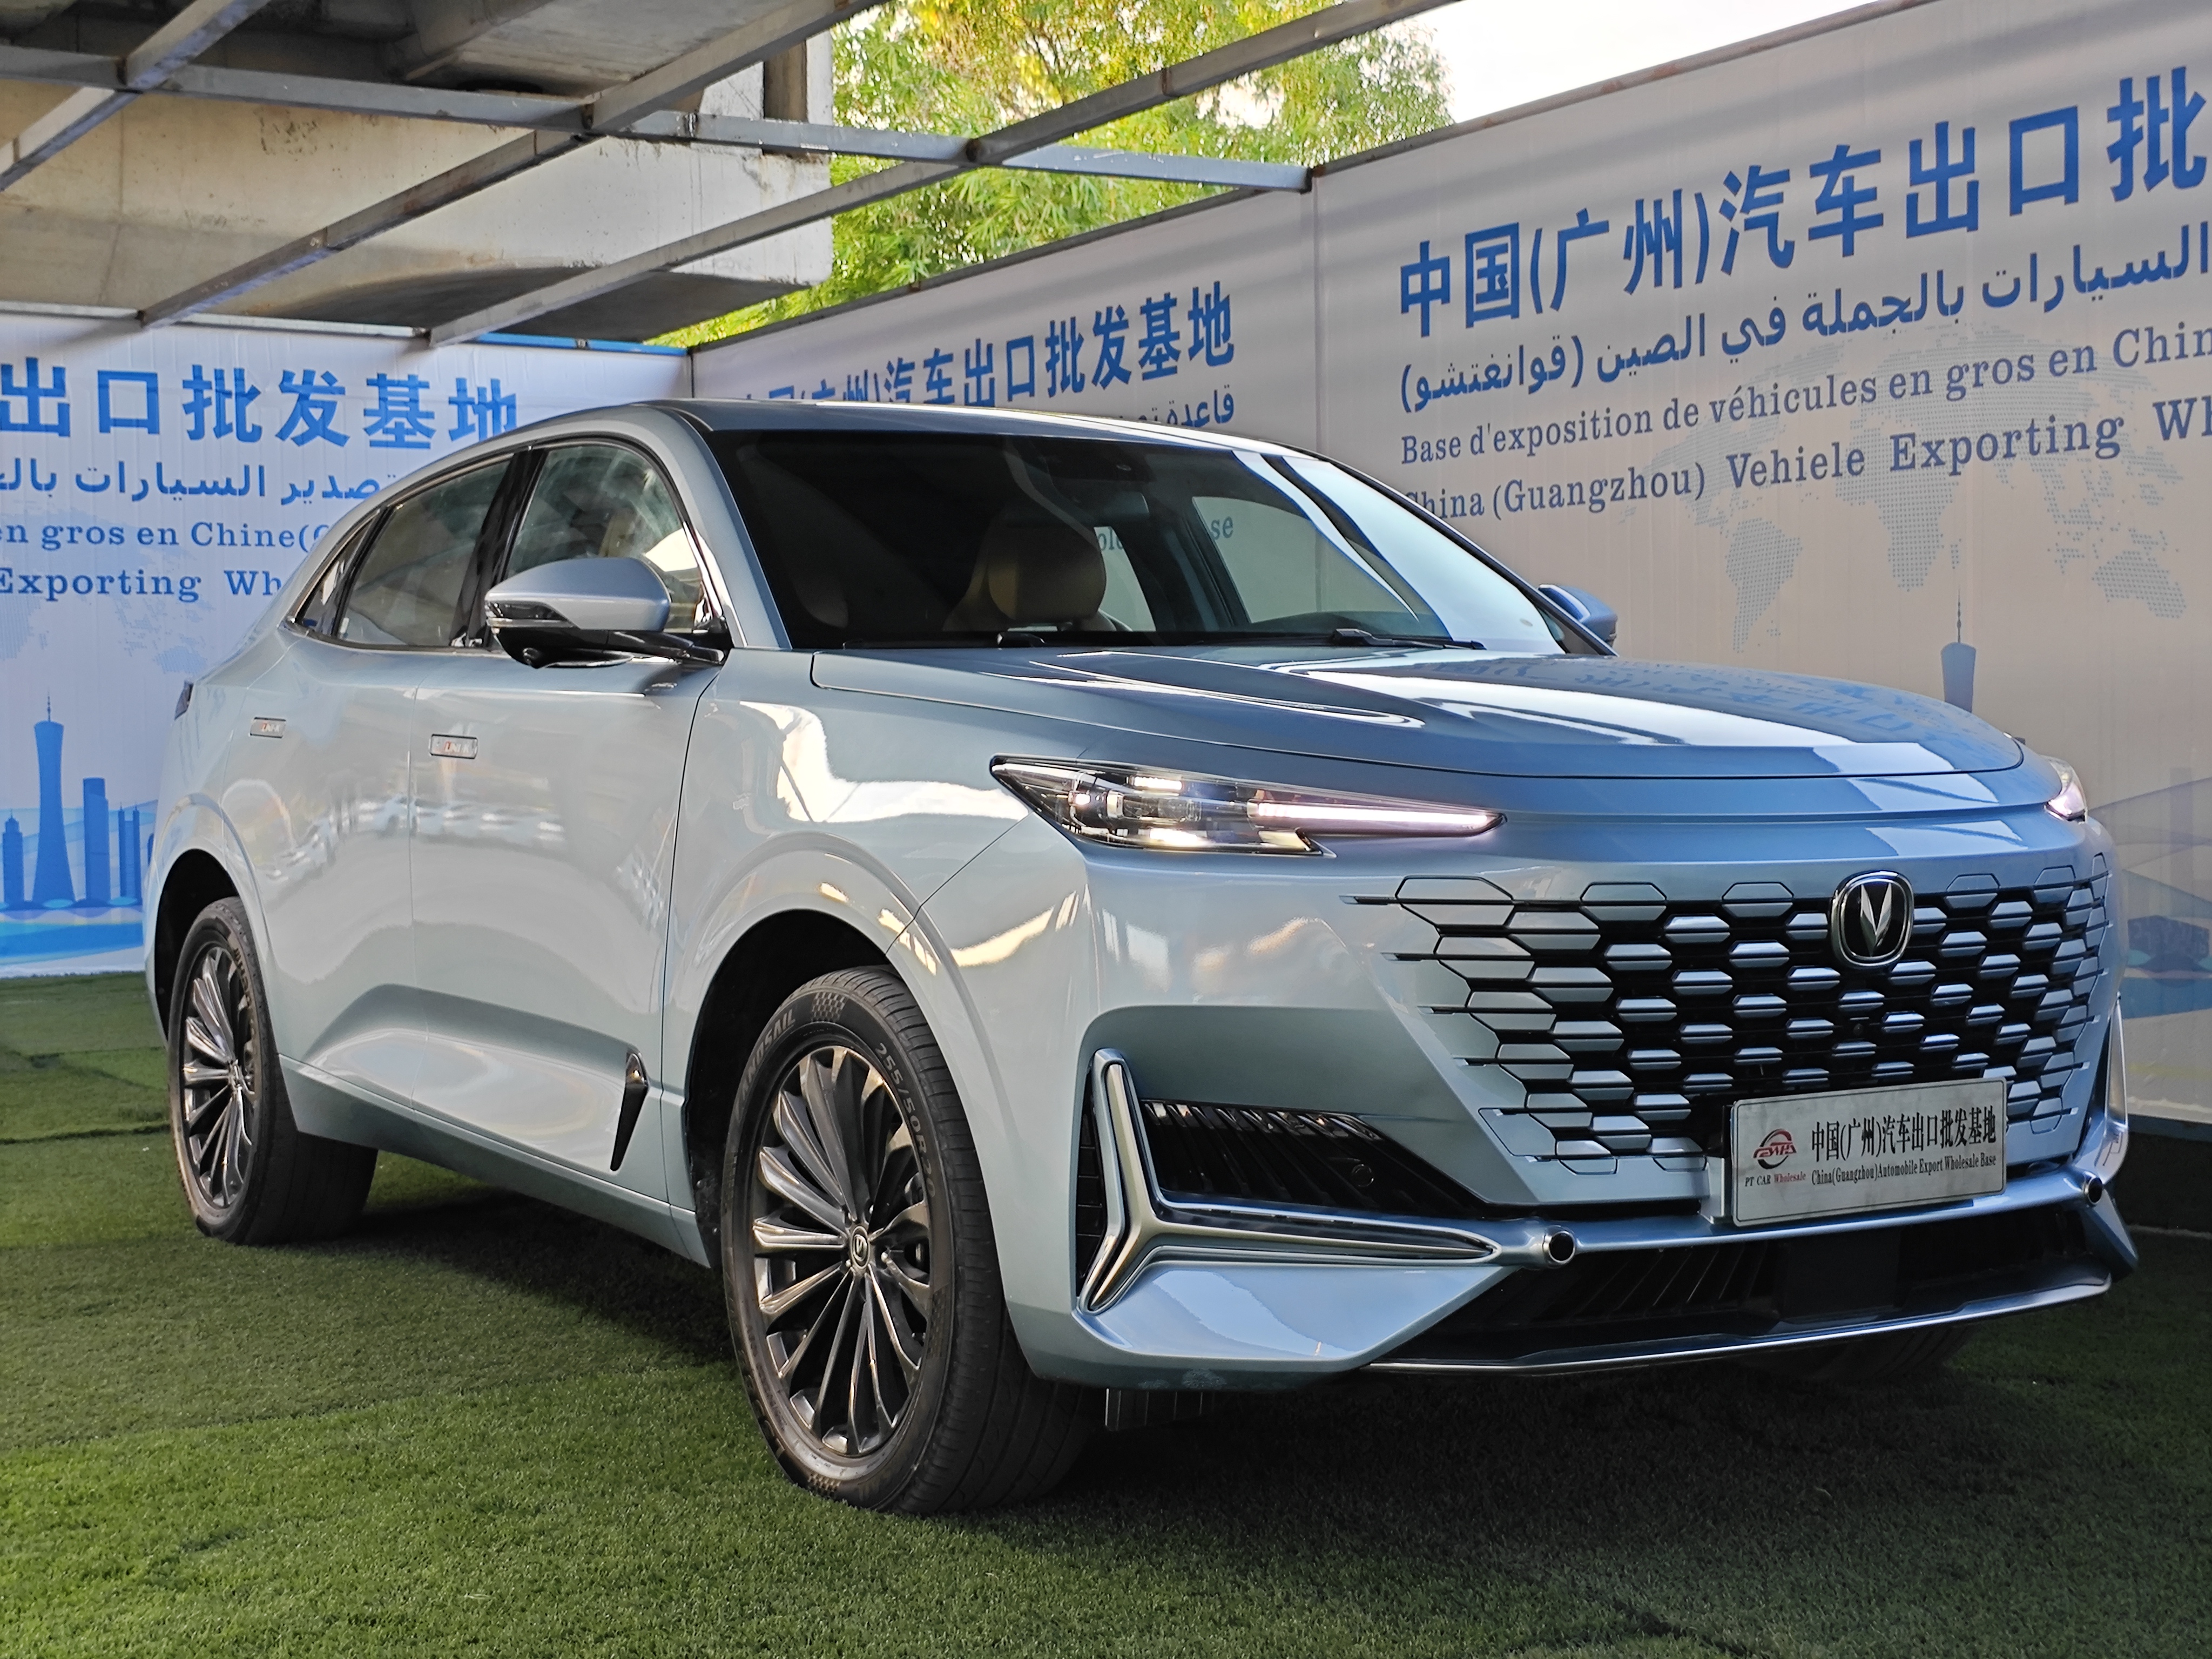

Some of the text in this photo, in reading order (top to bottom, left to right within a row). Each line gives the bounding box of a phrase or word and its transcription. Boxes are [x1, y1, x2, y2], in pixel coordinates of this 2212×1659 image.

[1401, 66, 2207, 338] 中国(广州)汽车出口批
[1401, 221, 2208, 413] السيارات بالجملة في الصين (قوانغتشو)
[0, 356, 517, 450] 出口批发基地
[1401, 435, 1461, 464] Base
[1470, 407, 1653, 457] d'exposition
[1663, 398, 1699, 428] de
[1710, 374, 1877, 423] véhicules
[1889, 368, 1933, 399] en
[1946, 351, 2035, 401] gros
[2048, 345, 2097, 376] en
[76, 461, 265, 502] السيارات
[1493, 463, 1705, 520] (Guangzhou)
[1727, 443, 1865, 488] Vehiele
[1889, 414, 2125, 476] Exporting
[0, 524, 29, 543] n
[42, 525, 125, 551] gros
[137, 526, 179, 545] en
[0, 567, 201, 603] Exporting
[1811, 1105, 1997, 1163] 中国(广州)汽车出口批发基地
[1745, 1170, 1806, 1187] PT CAR Wholesale
[1919, 1158, 1943, 1176] Export
[1945, 1152, 1979, 1171] Wholesale
[1980, 1152, 1997, 1167] Base
